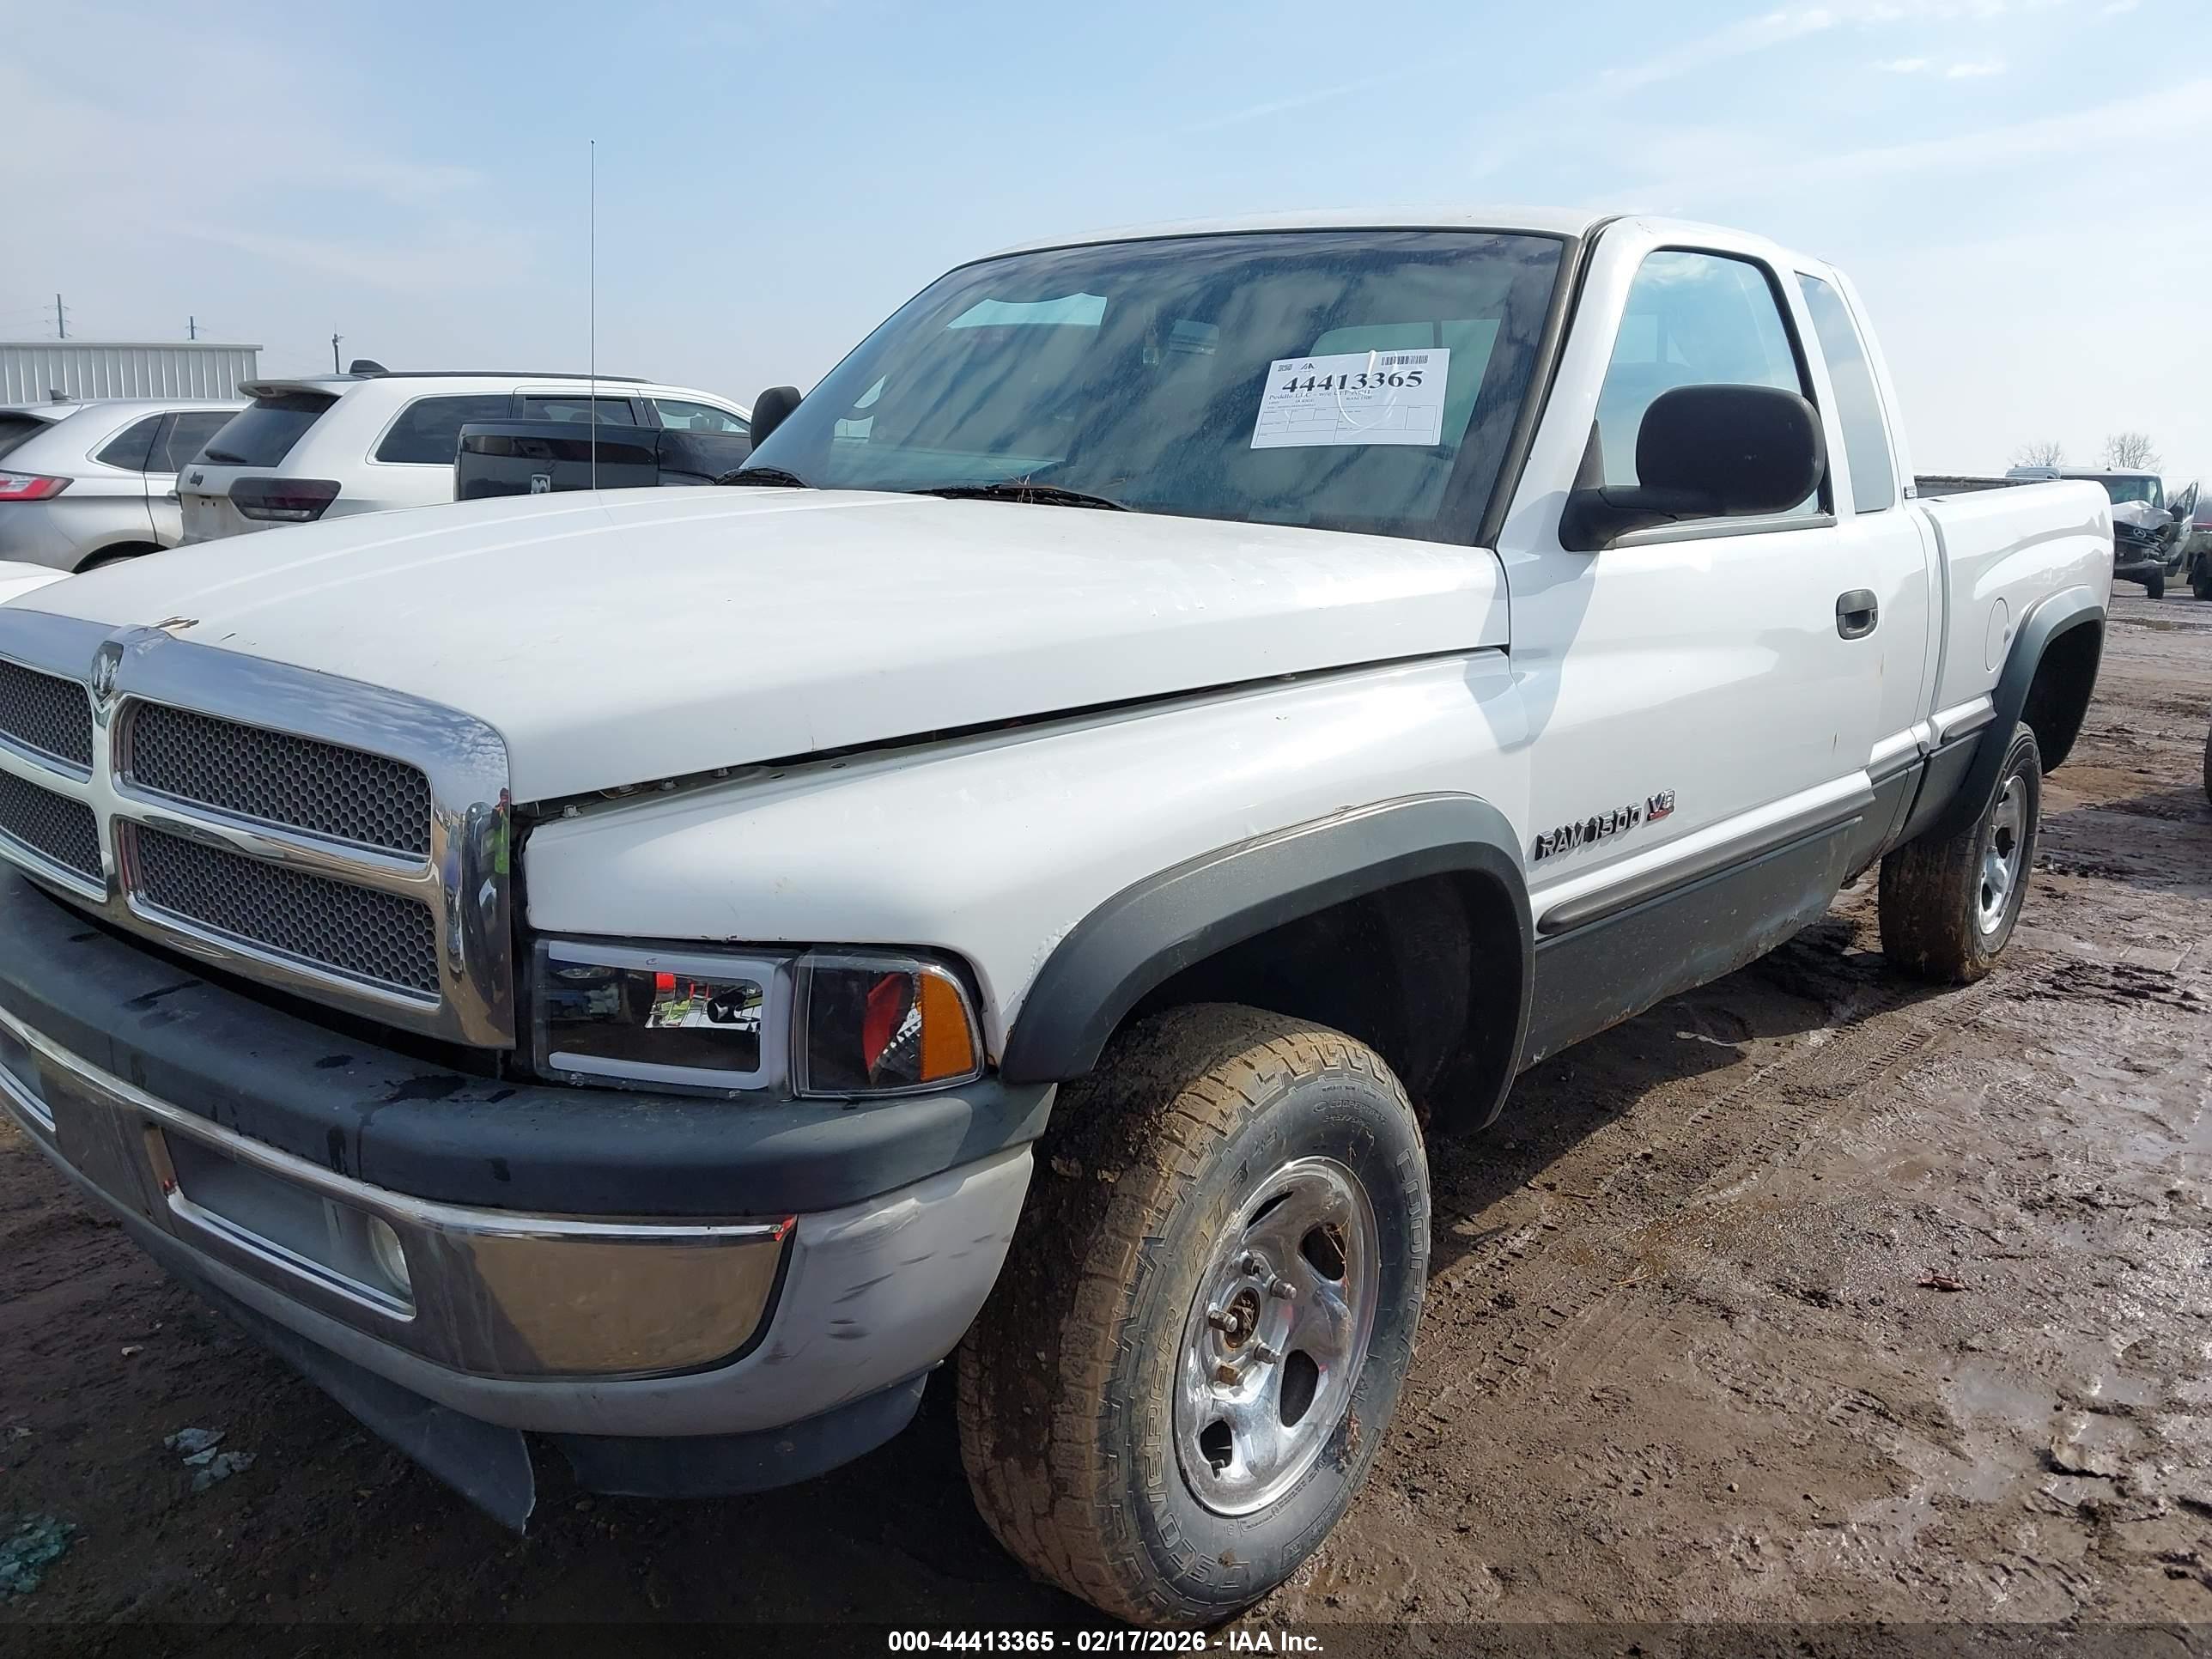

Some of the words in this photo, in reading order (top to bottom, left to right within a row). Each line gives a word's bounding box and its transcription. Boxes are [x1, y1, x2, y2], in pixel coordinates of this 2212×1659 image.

[1281, 370, 1425, 393] 44413365
[1534, 822, 1589, 861] RAM
[1587, 803, 1642, 842] 1500
[1395, 1147, 1425, 1382] COOPER
